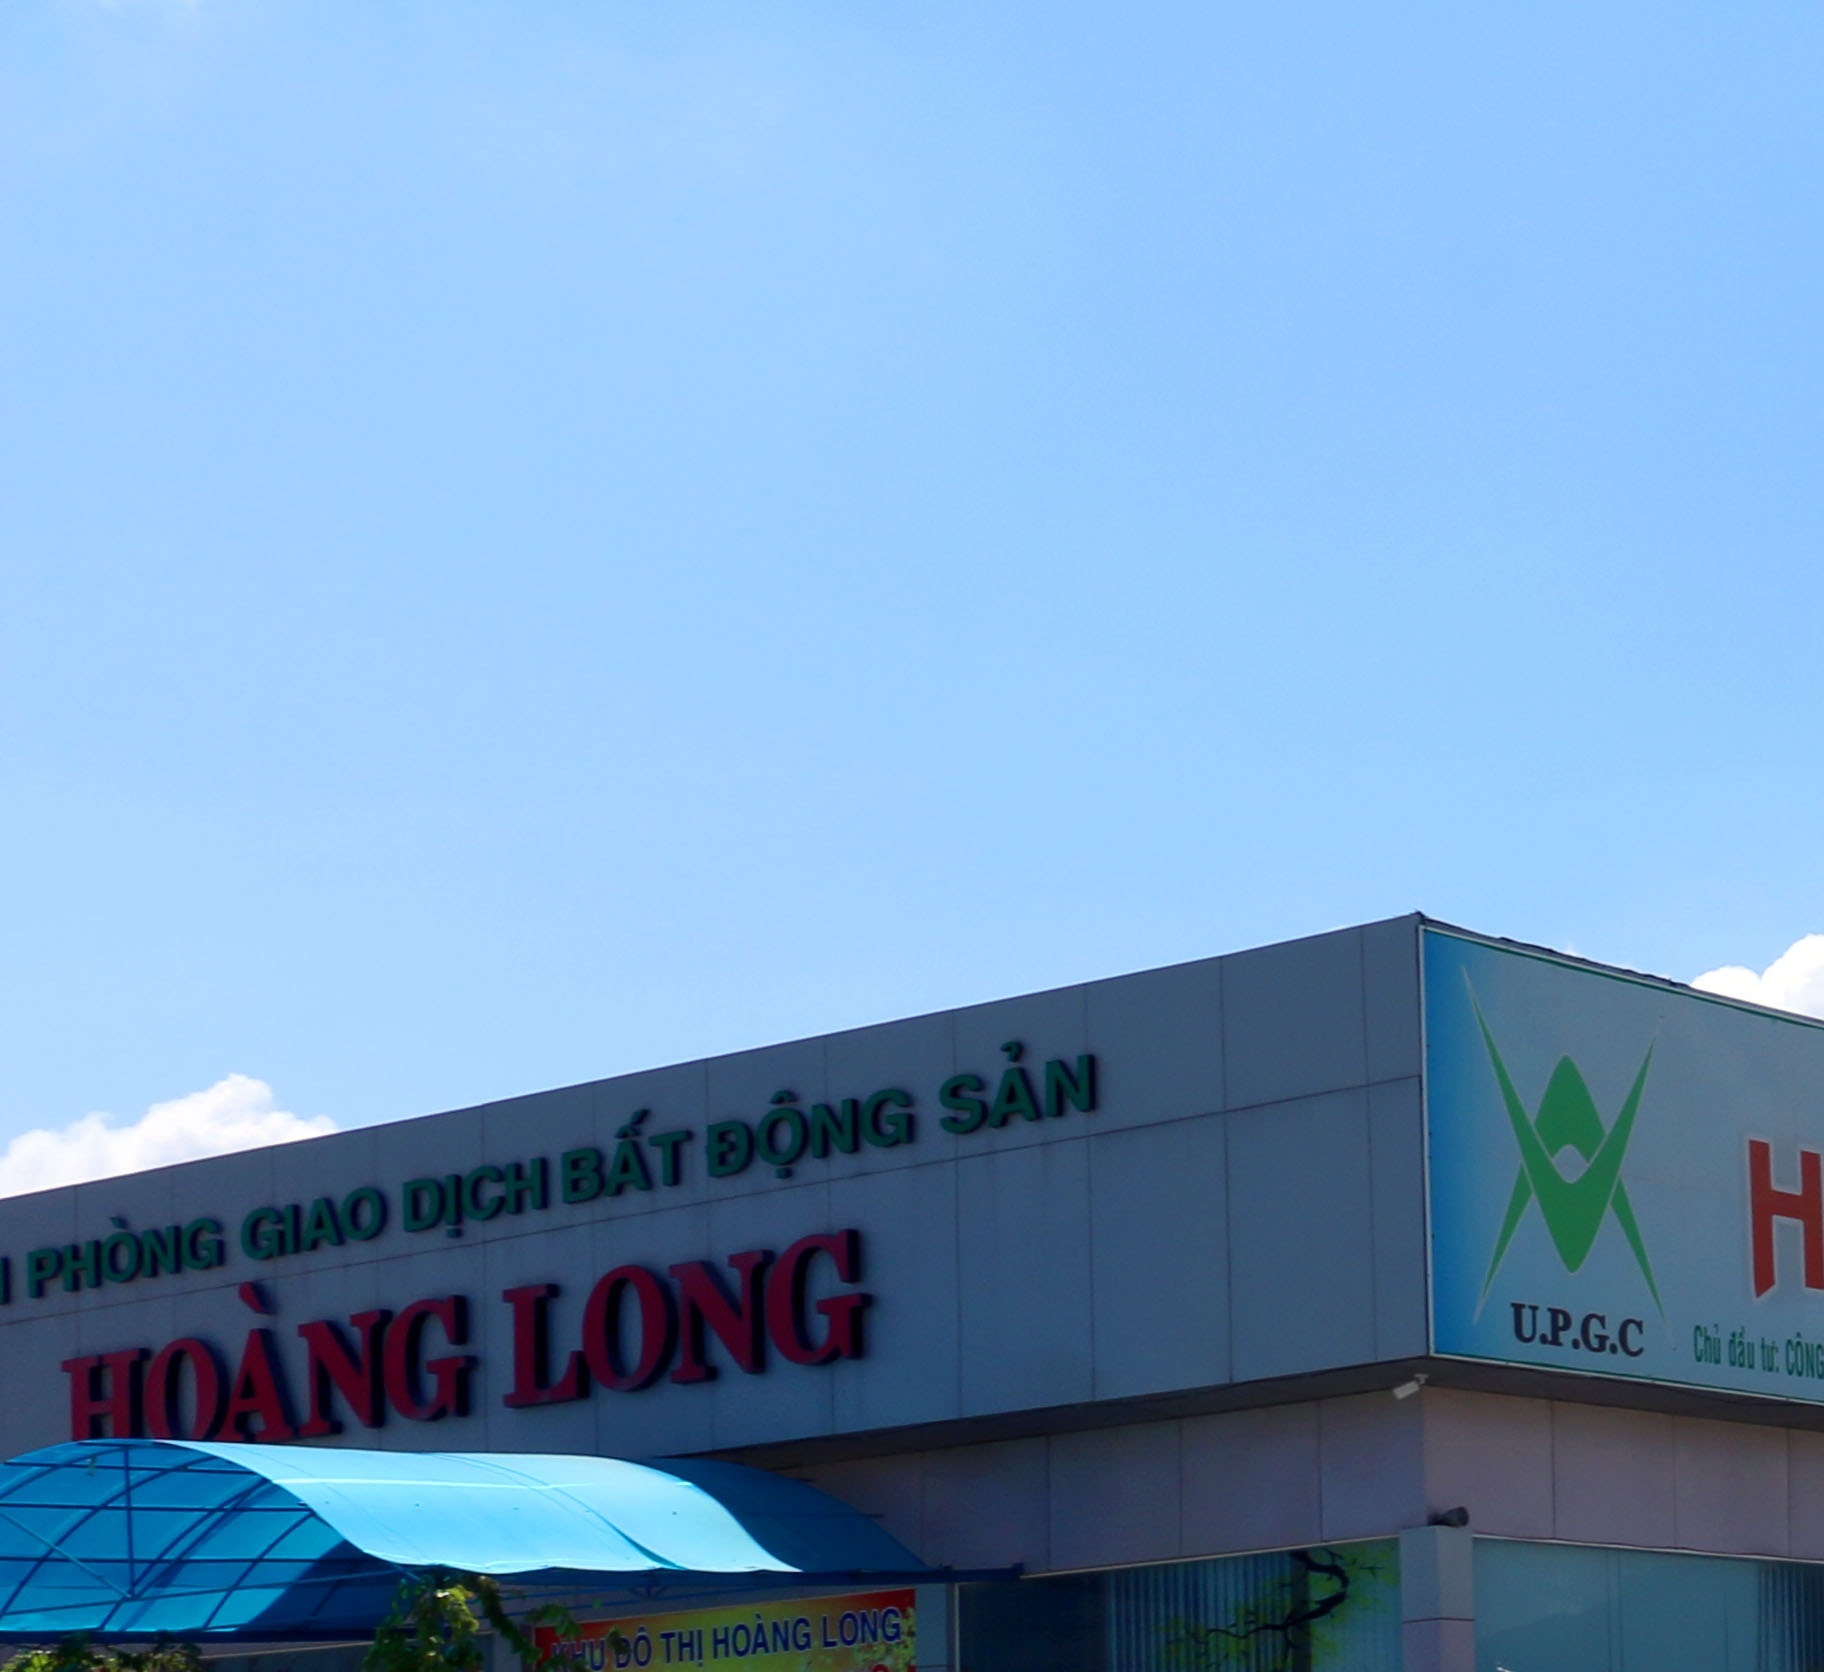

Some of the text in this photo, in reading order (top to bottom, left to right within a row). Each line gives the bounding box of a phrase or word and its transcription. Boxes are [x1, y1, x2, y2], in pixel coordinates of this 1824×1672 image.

[26, 1217, 225, 1298] PHÒNG
[240, 1187, 387, 1262] GIAO
[401, 1156, 548, 1238] DỊCH
[560, 1108, 693, 1204] BẤT
[705, 1089, 913, 1180] ĐỘNG
[938, 1039, 1097, 1134] SẢN
[61, 1228, 872, 1447] HOÀNG LONG
[1510, 1302, 1645, 1357] U.P.G.C
[1694, 1324, 1722, 1365] Chủ
[1728, 1327, 1756, 1370] đầu
[660, 1628, 704, 1667] THỊ
[713, 1613, 811, 1660] HOÀNG
[822, 1608, 901, 1649] LONG
